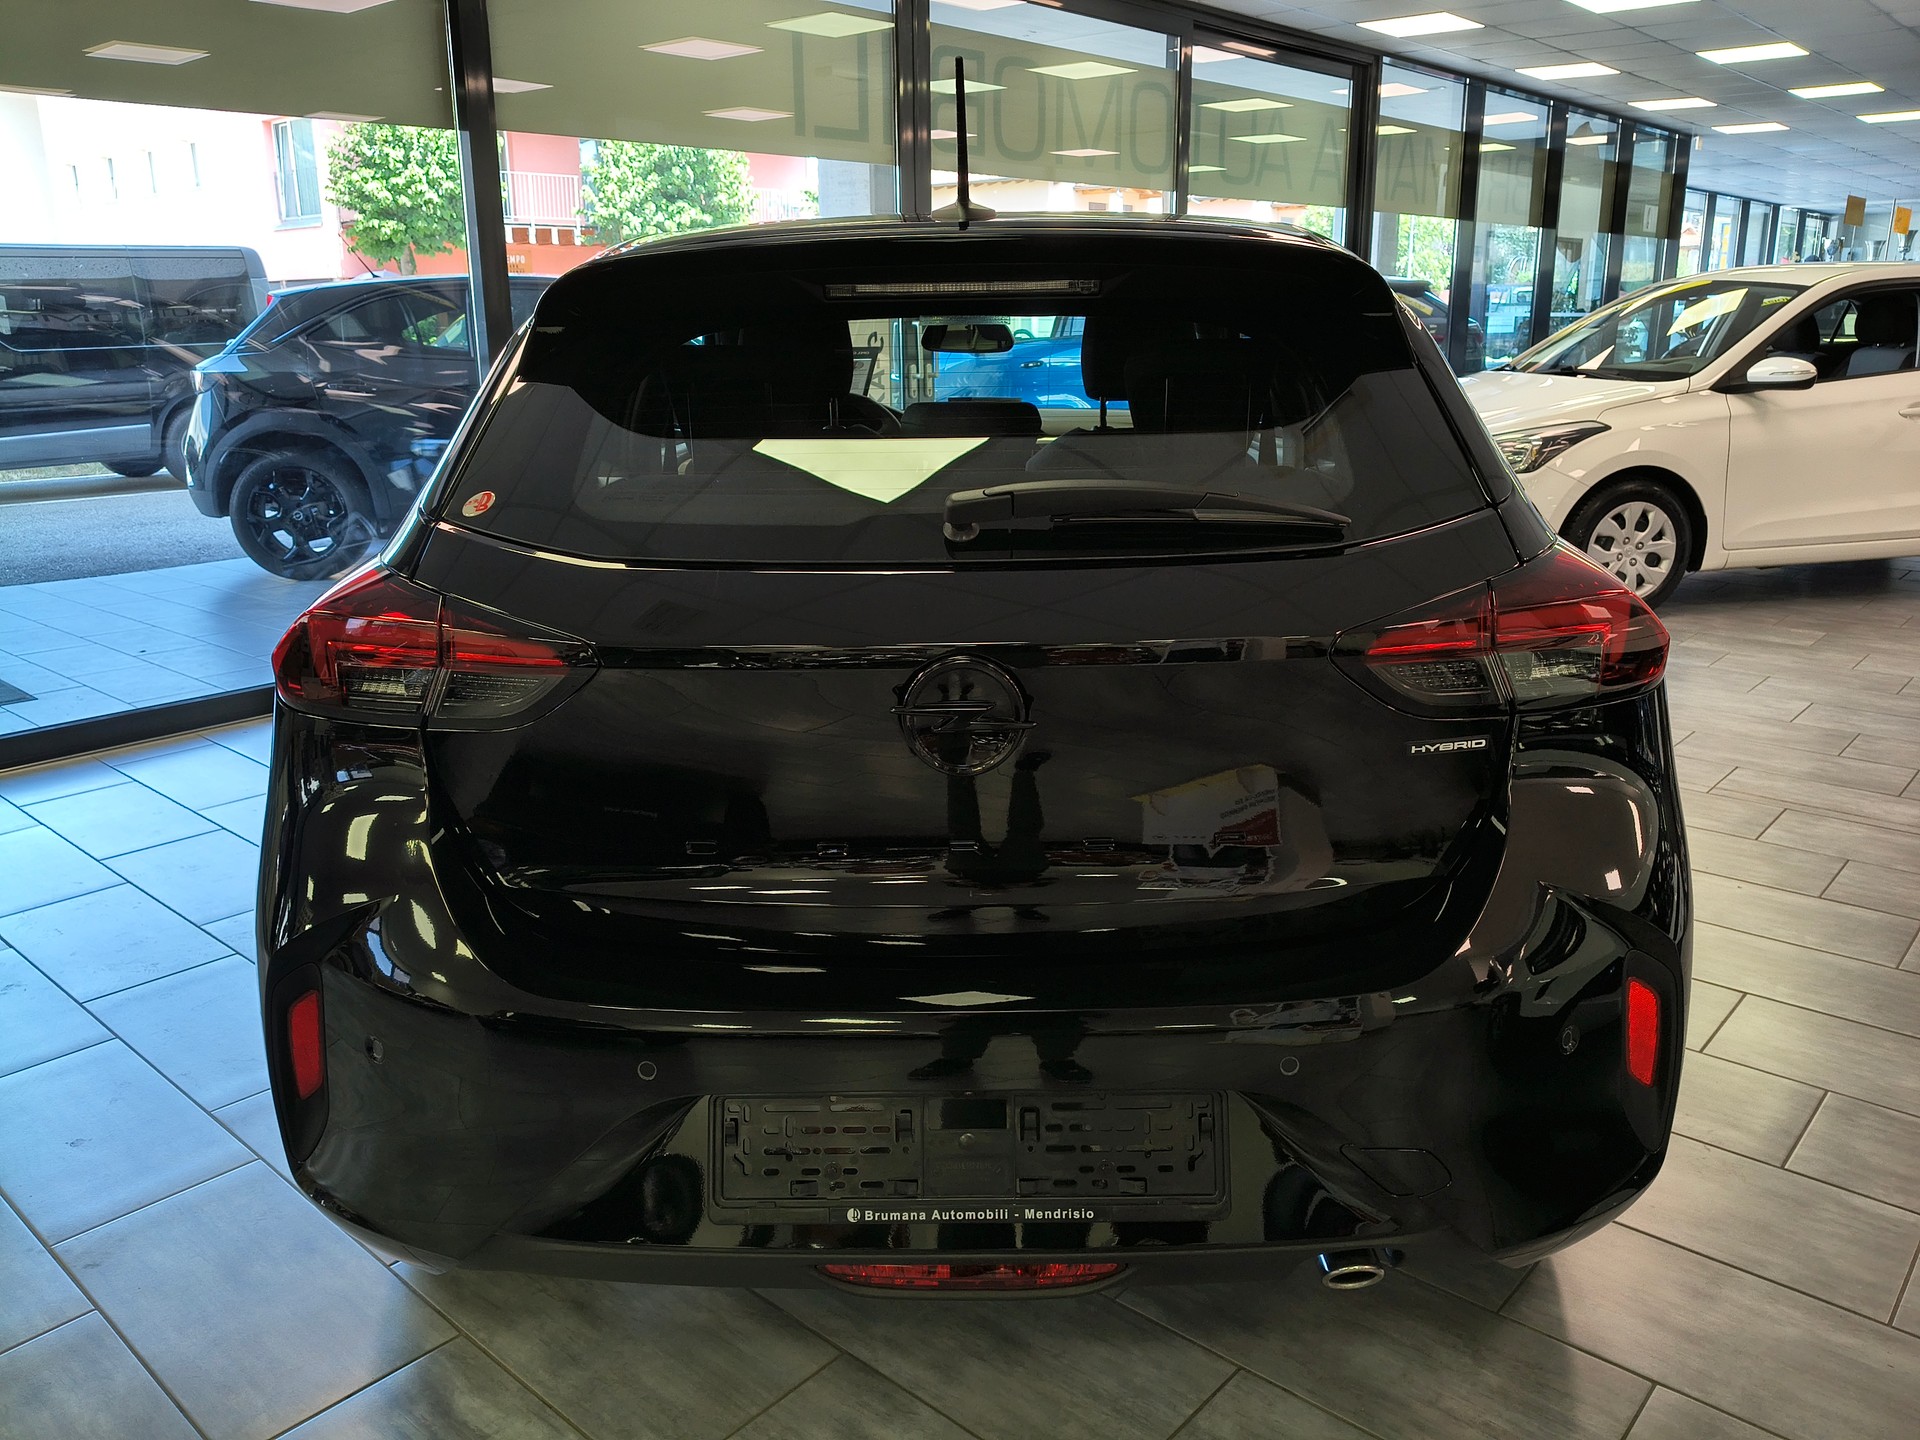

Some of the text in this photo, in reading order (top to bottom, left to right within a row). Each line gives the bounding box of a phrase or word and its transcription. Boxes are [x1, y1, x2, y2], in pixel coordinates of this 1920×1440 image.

[1411, 739, 1486, 754] HYBRID
[864, 1209, 927, 1221] Brumana
[931, 1208, 1009, 1221] Automobili
[1024, 1208, 1095, 1220] Mendrisio
